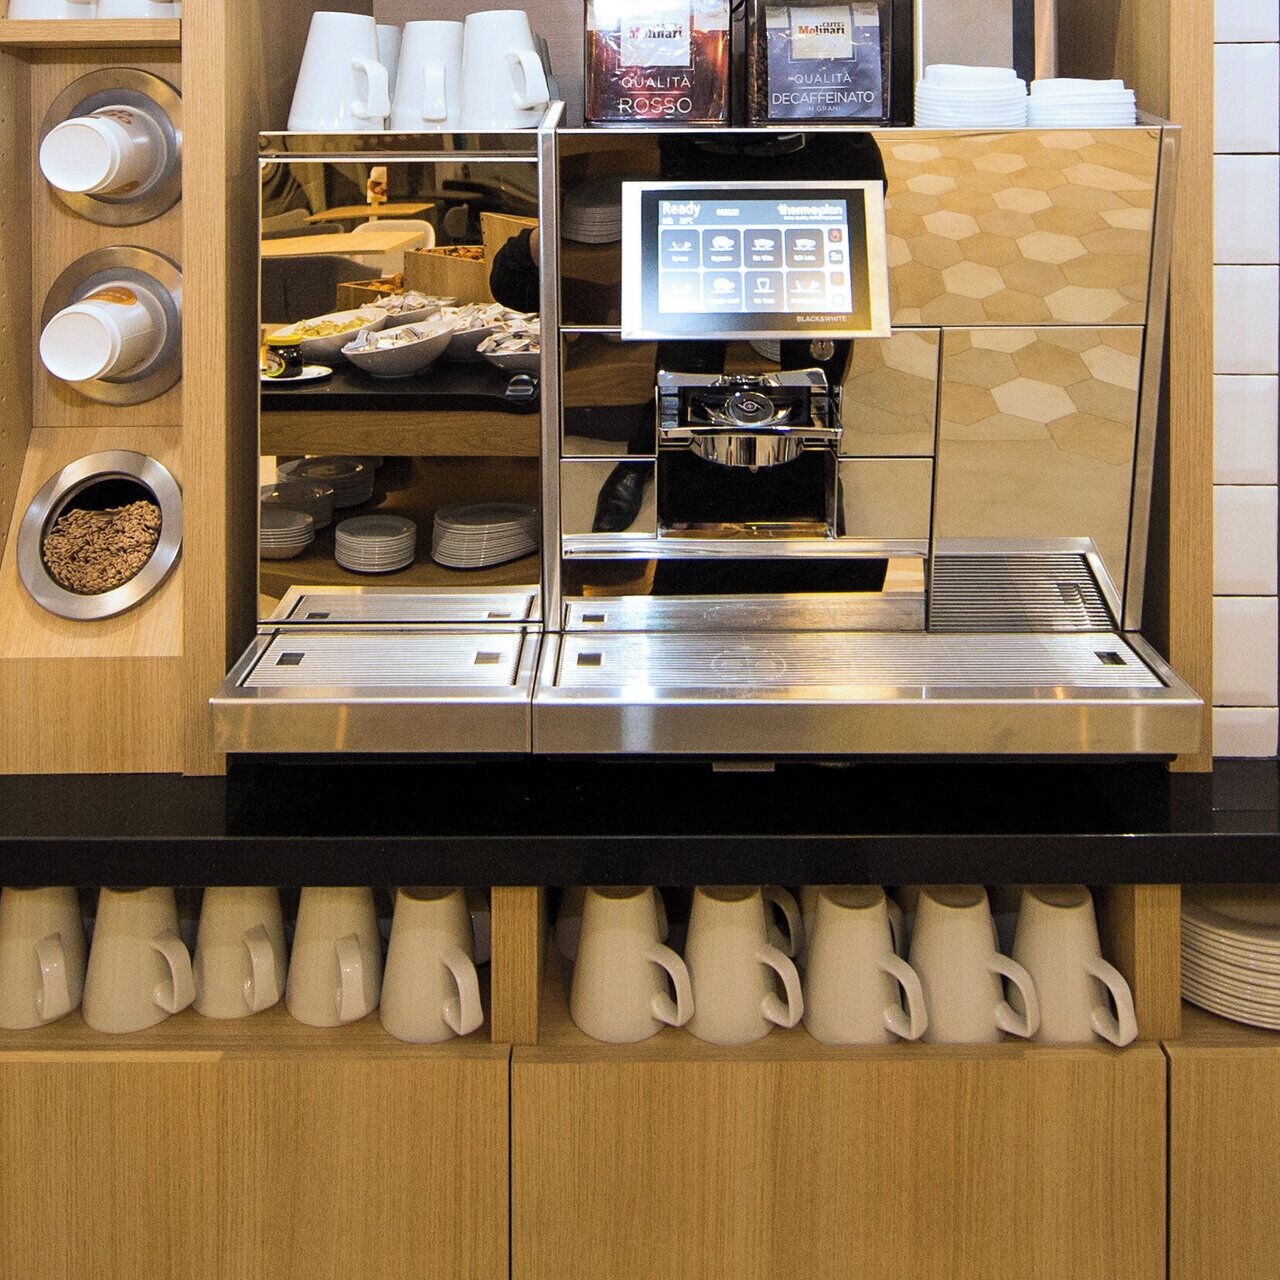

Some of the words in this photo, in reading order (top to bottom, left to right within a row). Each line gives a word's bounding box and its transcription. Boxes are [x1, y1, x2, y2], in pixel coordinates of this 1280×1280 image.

[798, 25, 845, 35] Molinari
[621, 74, 691, 88] QUALITÀ
[794, 71, 852, 84] QUALITÀ
[772, 91, 875, 105] DECAFFEINATO
[619, 97, 692, 114] ROSSO
[662, 201, 700, 219] Ready
[796, 315, 848, 323] BLACK&WHITE
